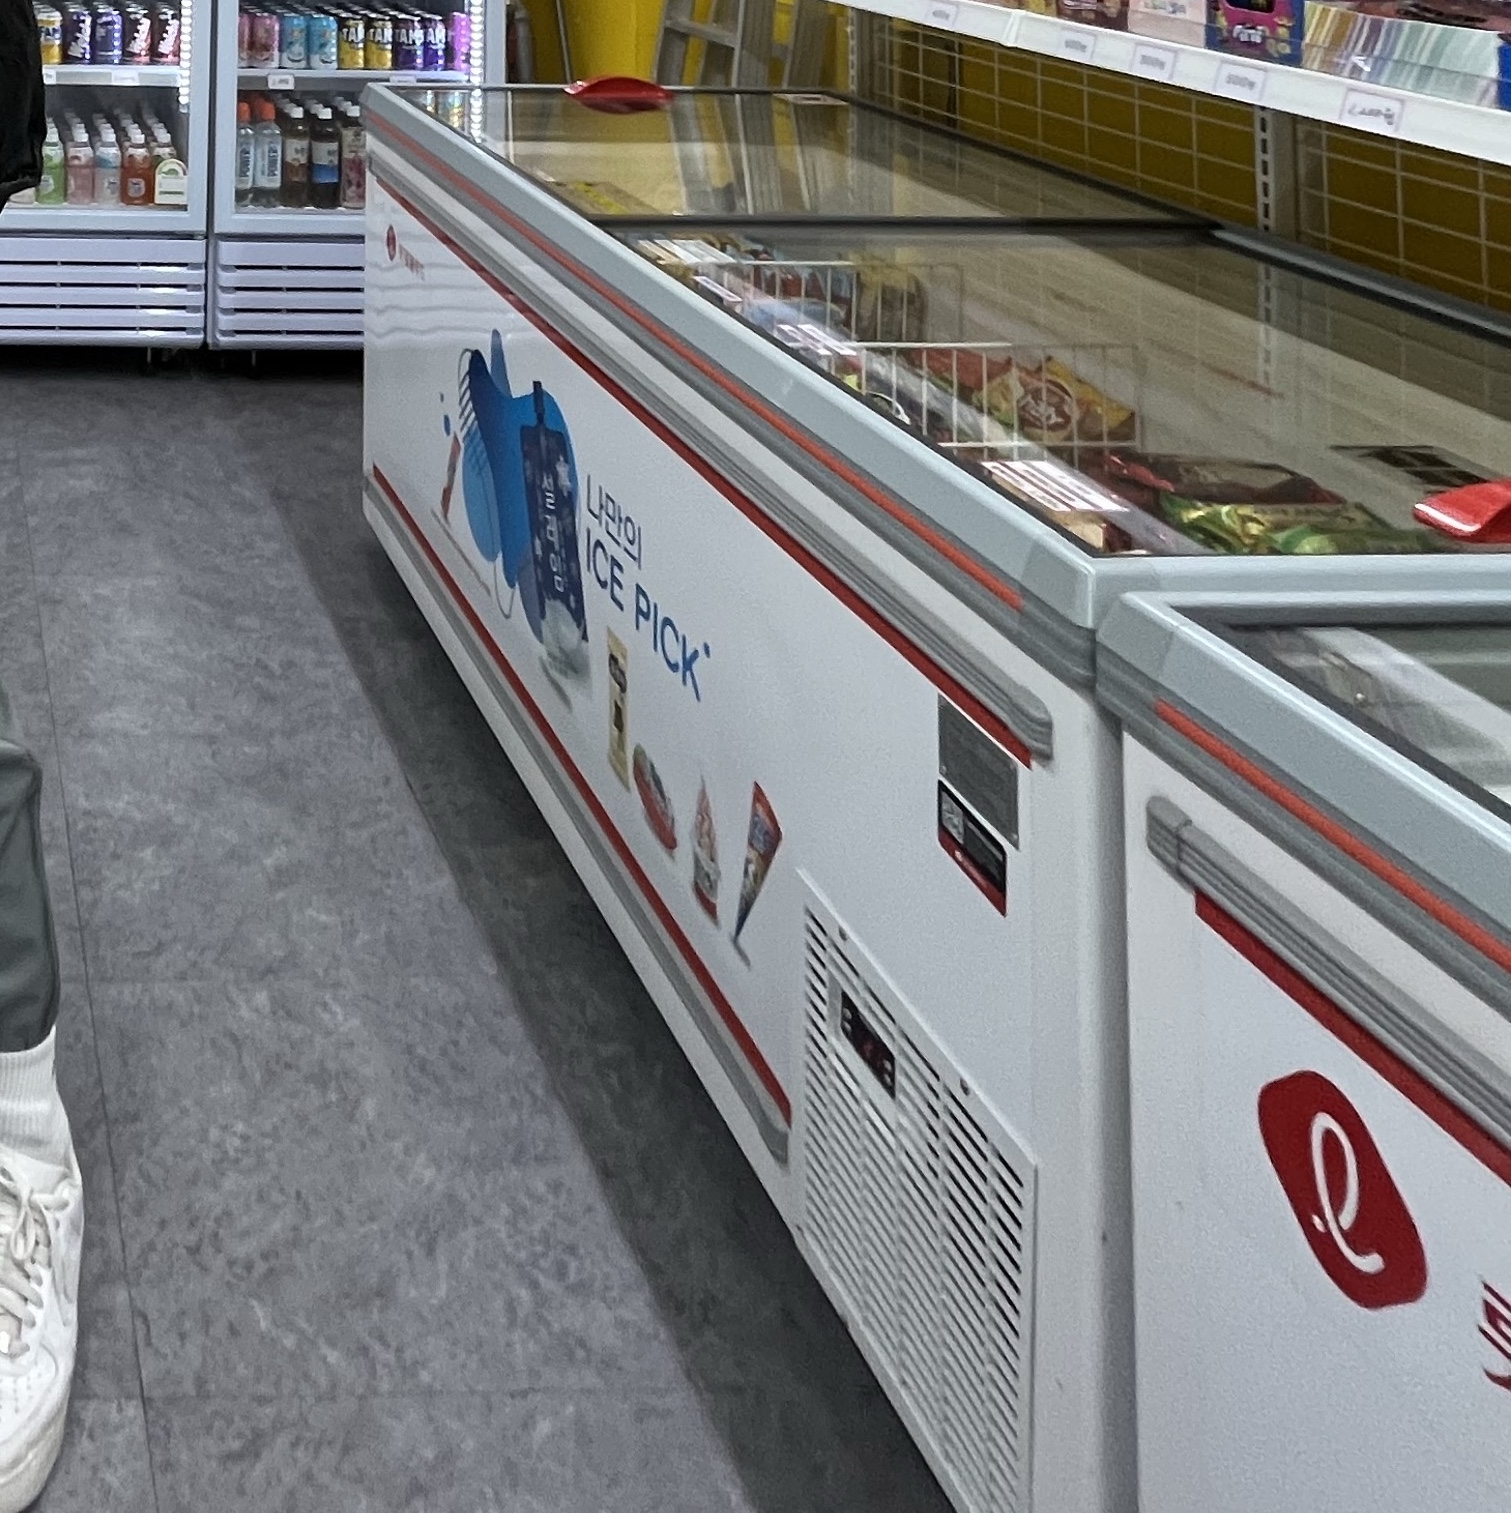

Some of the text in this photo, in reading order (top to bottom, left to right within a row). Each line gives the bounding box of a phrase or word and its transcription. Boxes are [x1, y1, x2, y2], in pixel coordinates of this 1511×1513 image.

[586, 474, 642, 571] 나만의
[586, 526, 701, 703] ICE PICK
